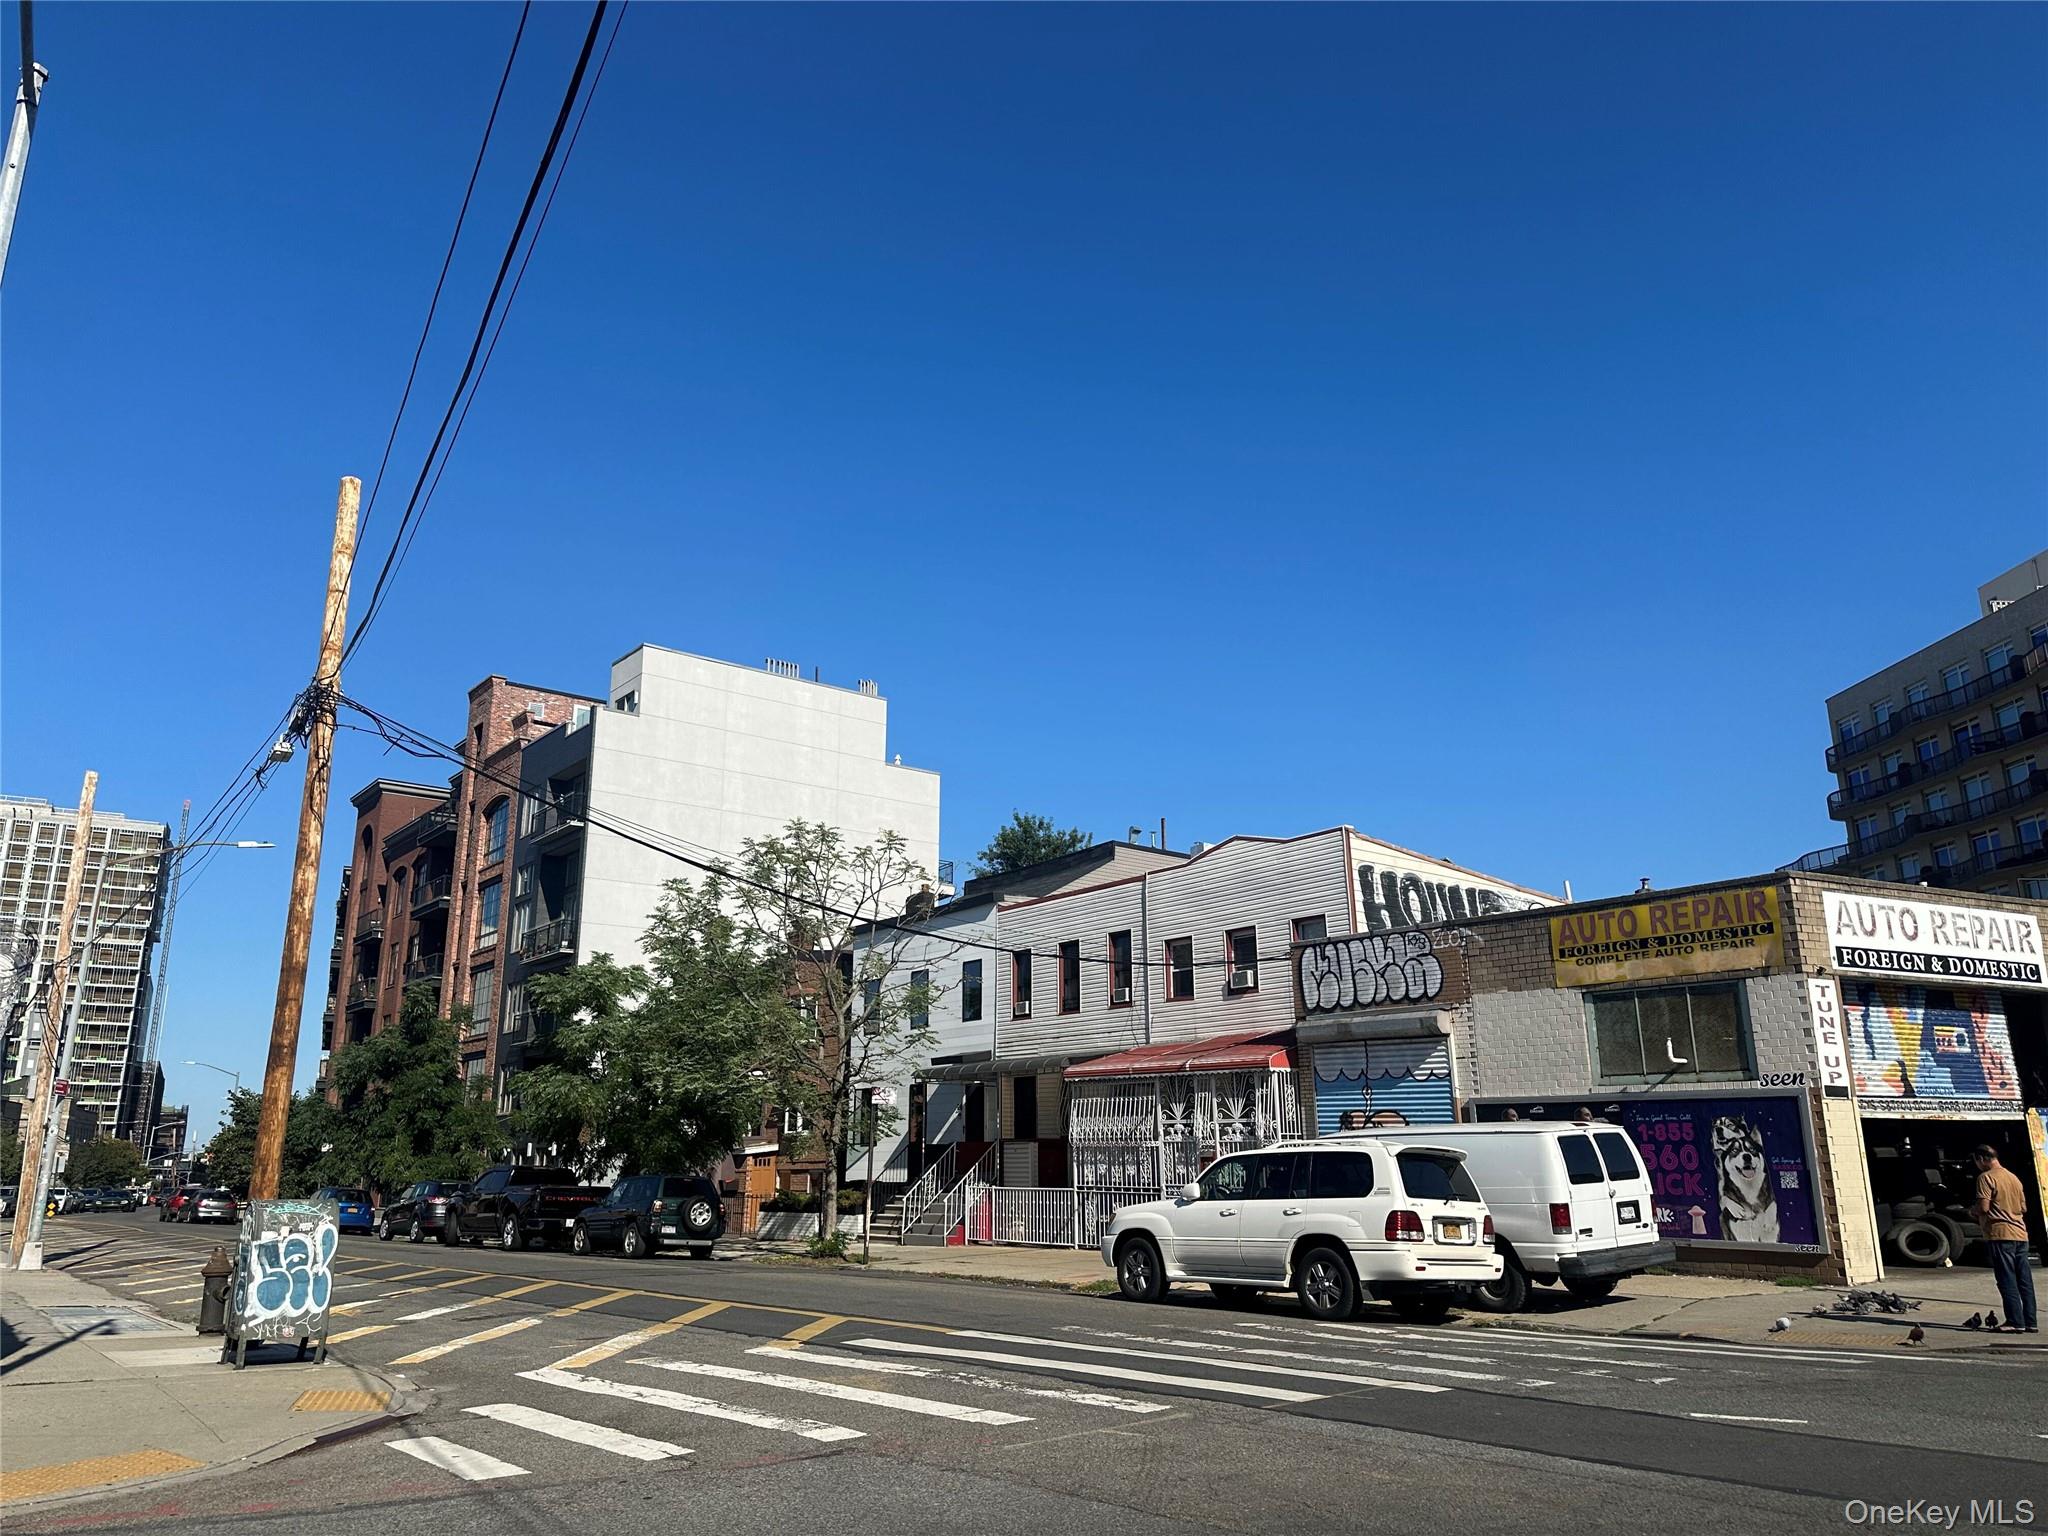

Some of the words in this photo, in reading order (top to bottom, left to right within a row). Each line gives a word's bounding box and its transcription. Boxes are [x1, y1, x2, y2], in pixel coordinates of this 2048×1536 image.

[1559, 909, 1638, 947] AUTO
[1650, 890, 1772, 935] REPAIR
[1836, 900, 1918, 941] AUTO
[1929, 909, 2037, 954] REPAIR
[1564, 939, 1641, 958] FOREIGN
[1647, 935, 1660, 948] &
[1666, 923, 1770, 946] DOMESTIC
[1575, 950, 1650, 967] COMPLETE
[1654, 945, 1695, 959] AUTO
[1701, 938, 1756, 952] REPAIR
[1841, 948, 1926, 971] FOREIGN
[1931, 956, 1944, 974] &
[1948, 957, 2039, 981] DOMESTIC
[1815, 984, 1838, 1045] TUNE
[1759, 1072, 1807, 1088] seen
[1824, 1055, 1843, 1084] UP
[1638, 1122, 1695, 1141] 1-855
[1640, 1144, 1699, 1170] 560
[1655, 1172, 1705, 1196] ICK
